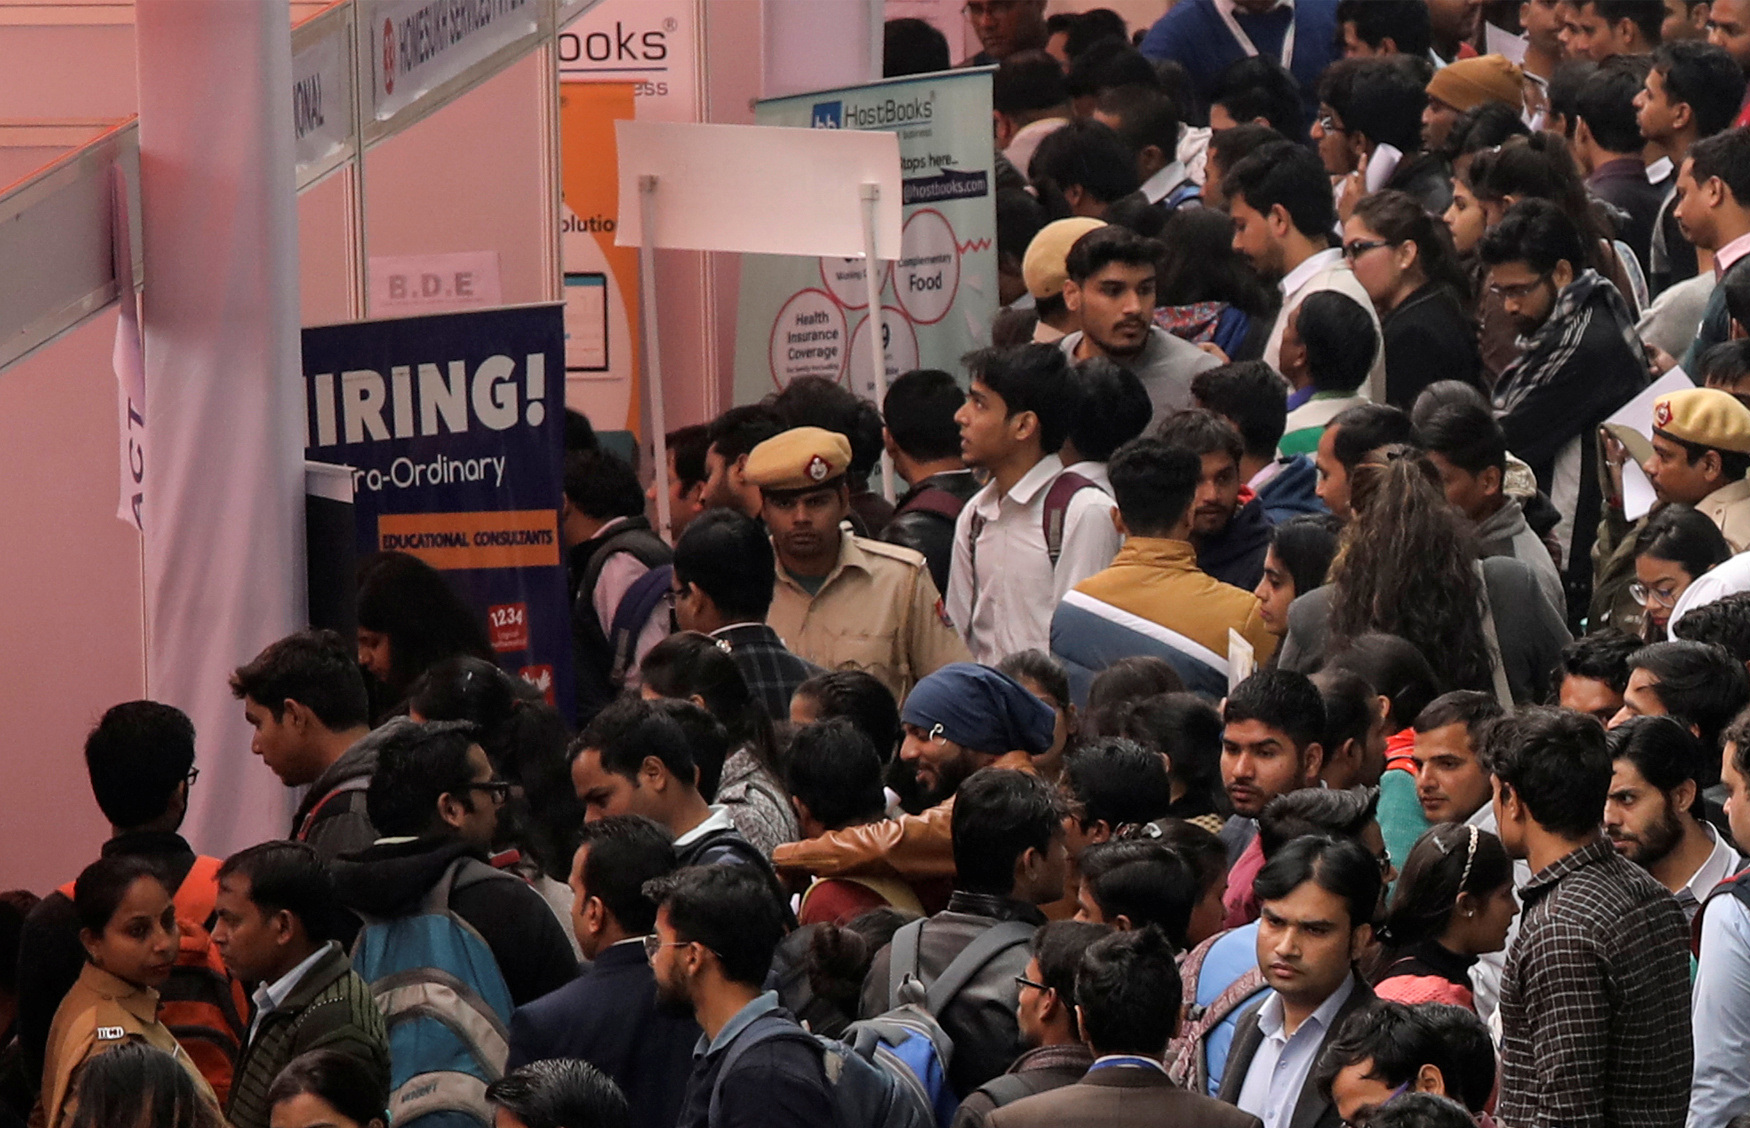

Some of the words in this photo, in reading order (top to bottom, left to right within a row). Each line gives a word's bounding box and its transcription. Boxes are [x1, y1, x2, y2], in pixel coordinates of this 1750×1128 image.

[559, 21, 667, 62] ooks
[845, 97, 933, 126] HostBooks
[900, 154, 926, 171] tops
[562, 215, 615, 232] olutio
[909, 271, 942, 293] Food
[796, 311, 829, 326] Health
[788, 329, 839, 344] Insurance
[788, 346, 838, 361] Coverage
[301, 352, 546, 450] IRING!
[351, 454, 505, 493] ra-Ordinary
[382, 533, 469, 550] EDUCATIONAL
[473, 530, 553, 548] CONSULTANTS
[491, 607, 523, 628] 1234
